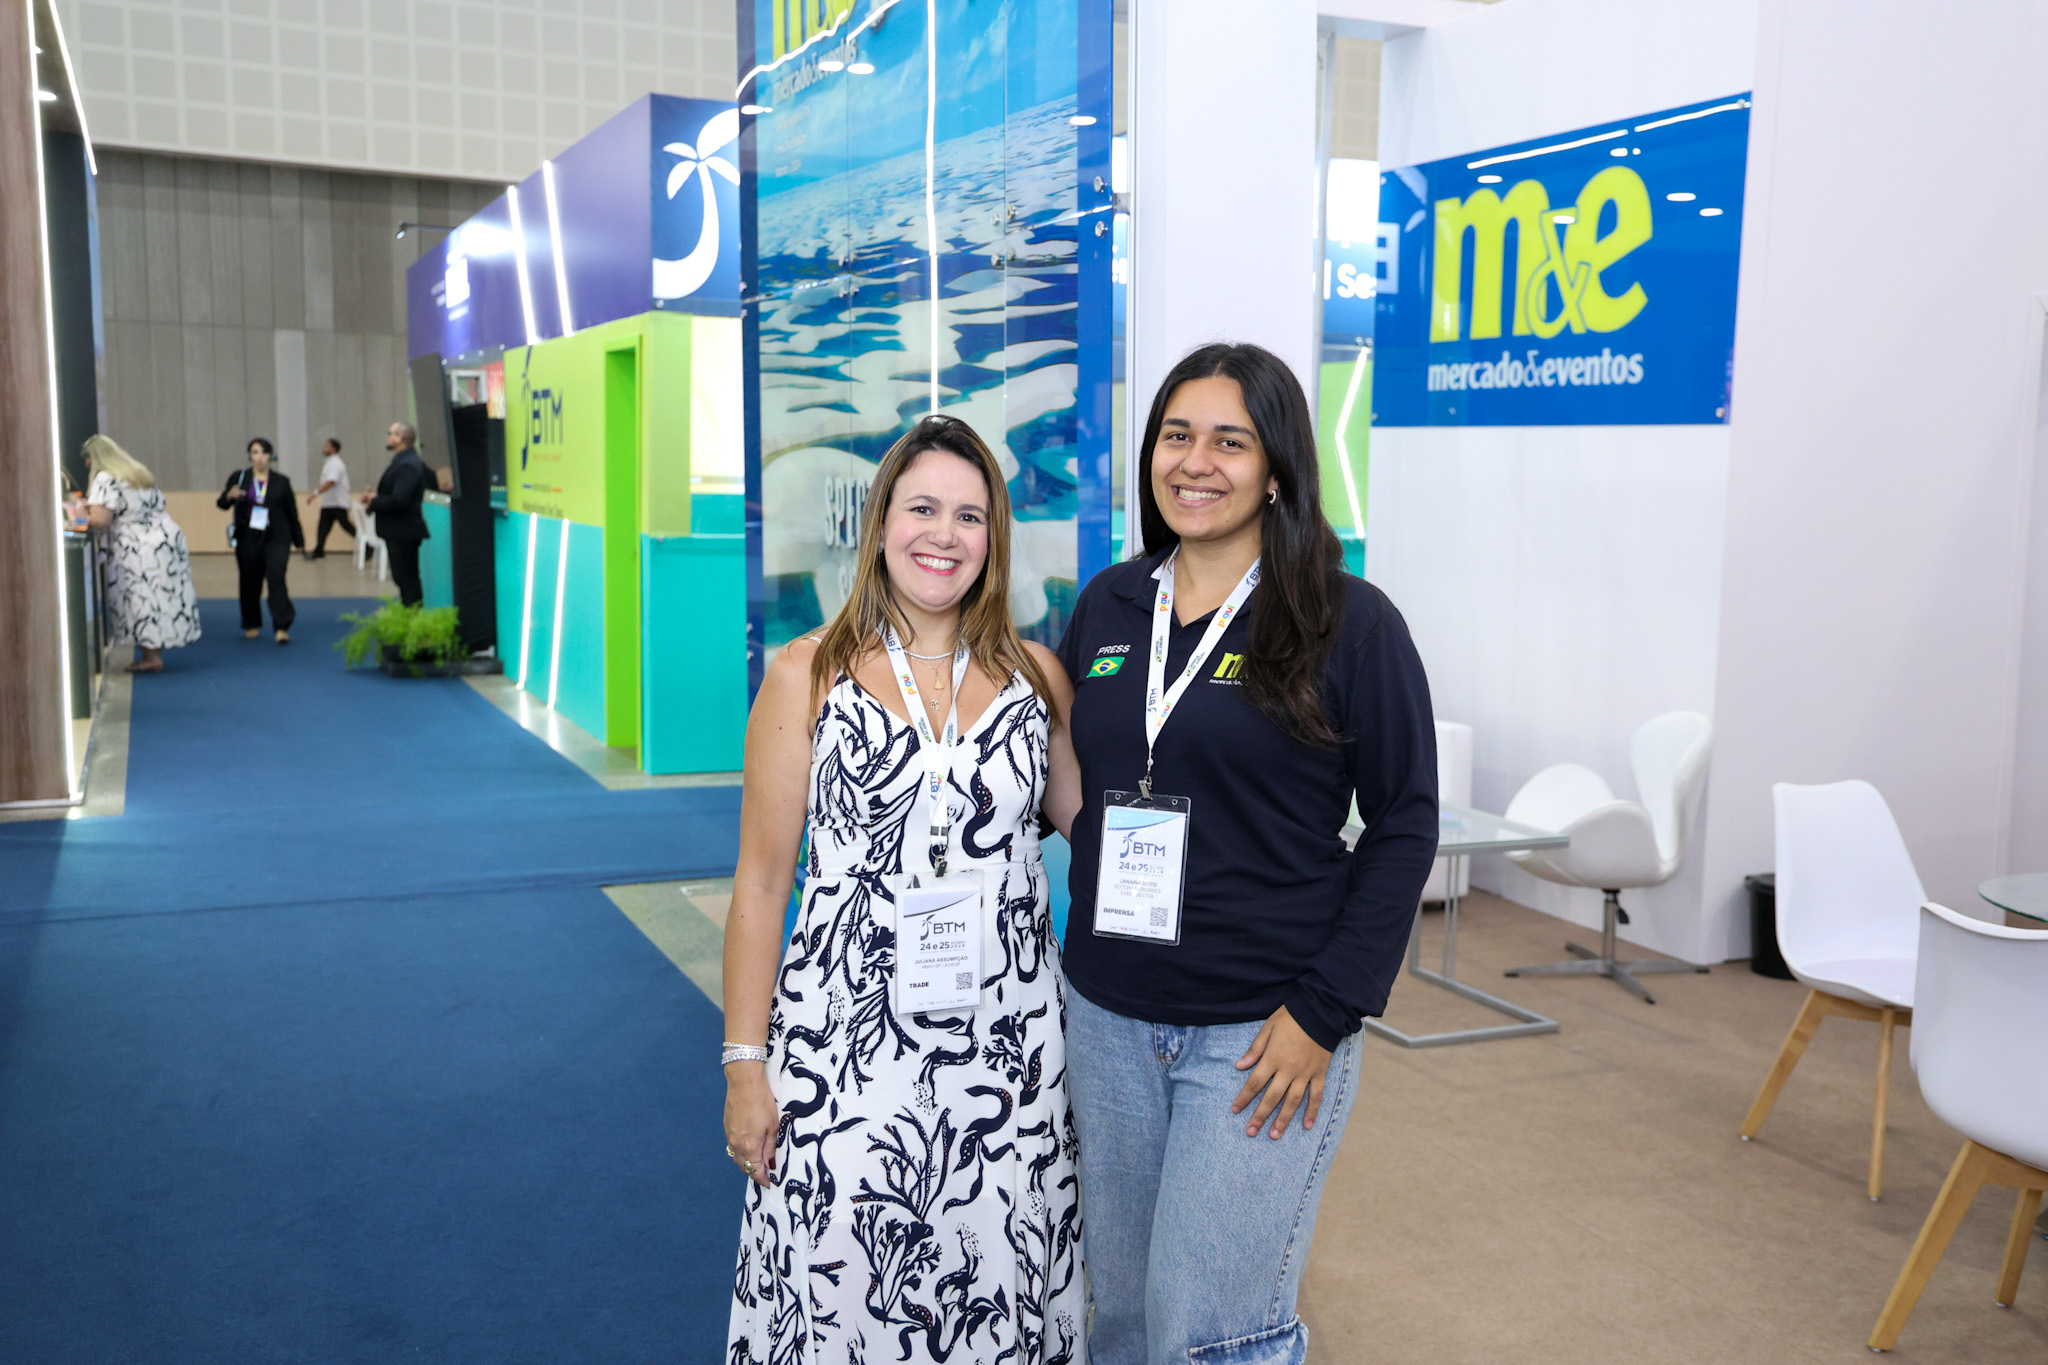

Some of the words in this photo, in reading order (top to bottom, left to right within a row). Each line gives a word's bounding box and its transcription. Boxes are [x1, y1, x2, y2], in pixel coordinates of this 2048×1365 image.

[1429, 166, 1653, 342] m&e
[1336, 263, 1377, 299] Se
[1427, 347, 1645, 392] mercado&eventos
[532, 388, 564, 445] BTM
[1096, 644, 1132, 656] PRESS
[1133, 842, 1166, 857] BTM
[1118, 861, 1130, 870] 24
[1103, 907, 1135, 917] IMPRENSA
[933, 921, 966, 934] BTM
[920, 943, 931, 951] 24
[939, 941, 950, 950] 25
[909, 981, 929, 989] TRADE
